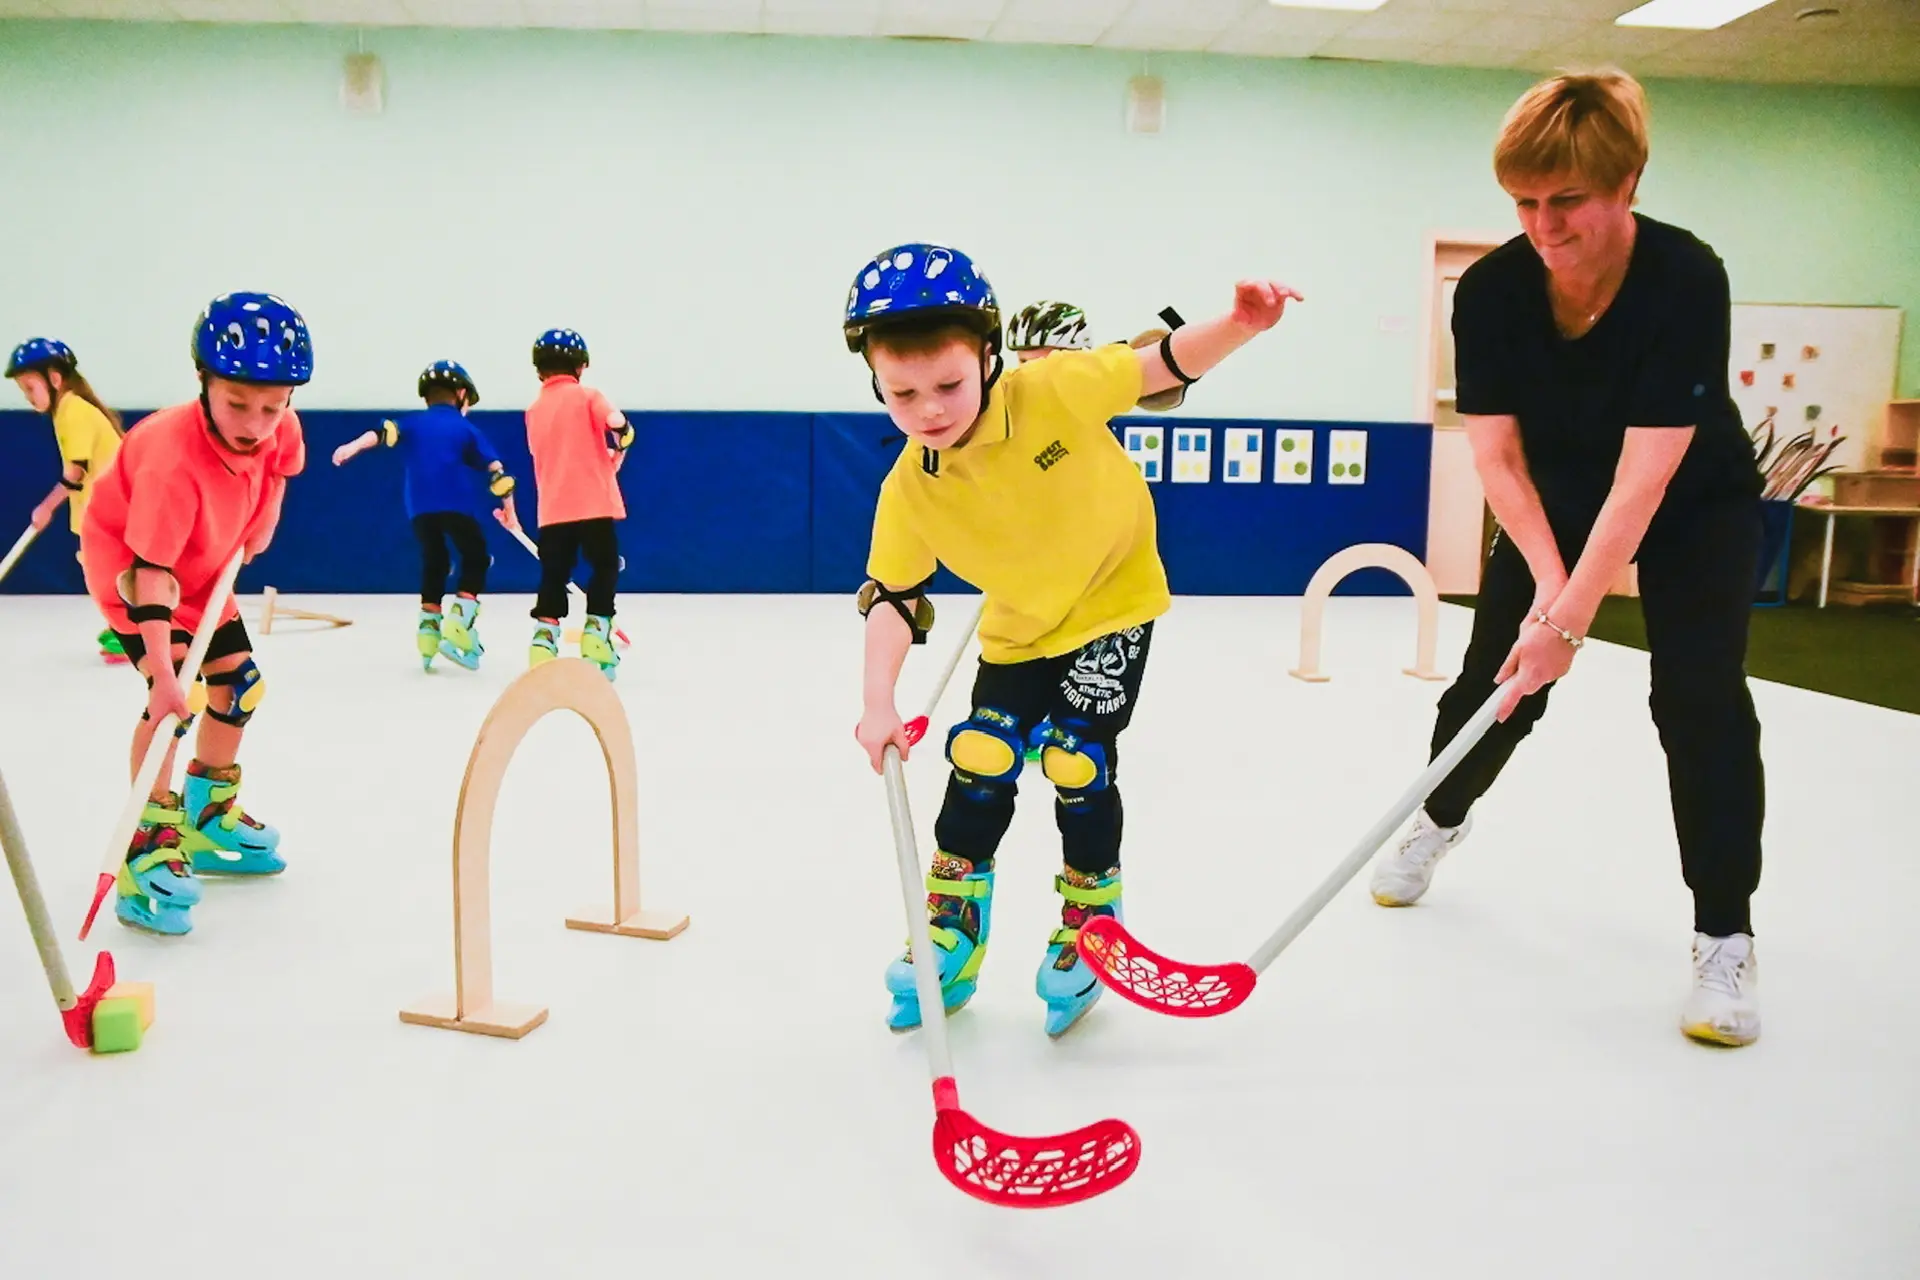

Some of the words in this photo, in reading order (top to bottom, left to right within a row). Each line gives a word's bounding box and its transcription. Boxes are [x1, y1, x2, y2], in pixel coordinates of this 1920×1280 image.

[1060, 680, 1092, 712] FIGHT
[1096, 692, 1128, 715] HARD
[1079, 684, 1113, 699] ATHLETIC
